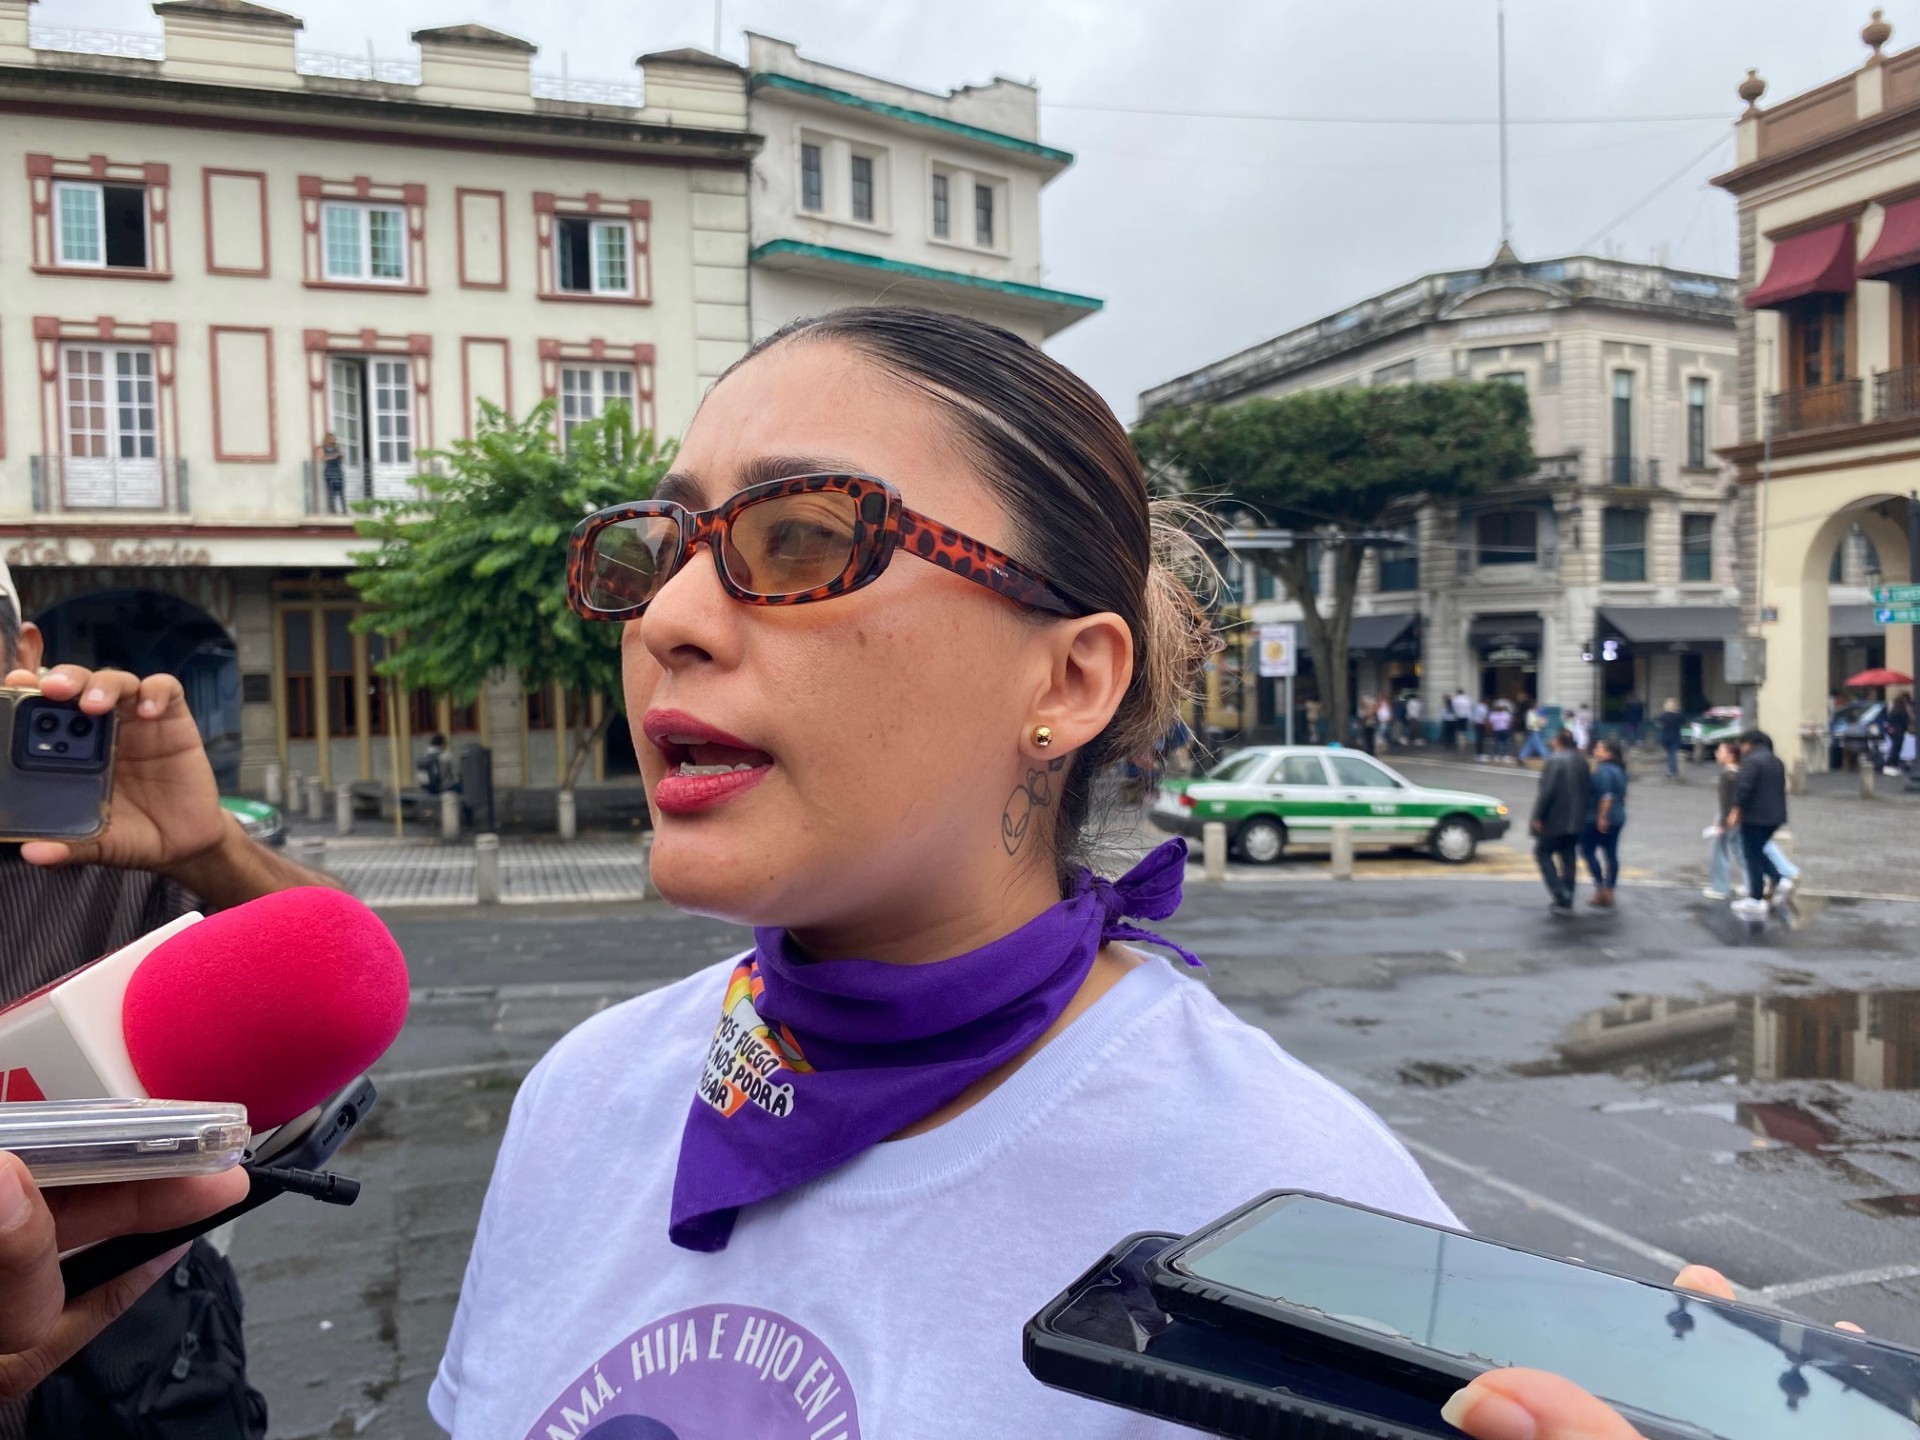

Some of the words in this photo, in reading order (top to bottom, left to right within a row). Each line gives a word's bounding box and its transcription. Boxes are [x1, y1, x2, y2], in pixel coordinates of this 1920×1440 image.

[734, 1030, 780, 1076] FUEGO
[732, 1064, 790, 1117] PODRÁ
[531, 1363, 622, 1440] AMÁ.
[630, 1318, 698, 1382] HIJA
[708, 1312, 730, 1360] E
[733, 1315, 804, 1382] HIJO
[793, 1356, 841, 1424] EN
